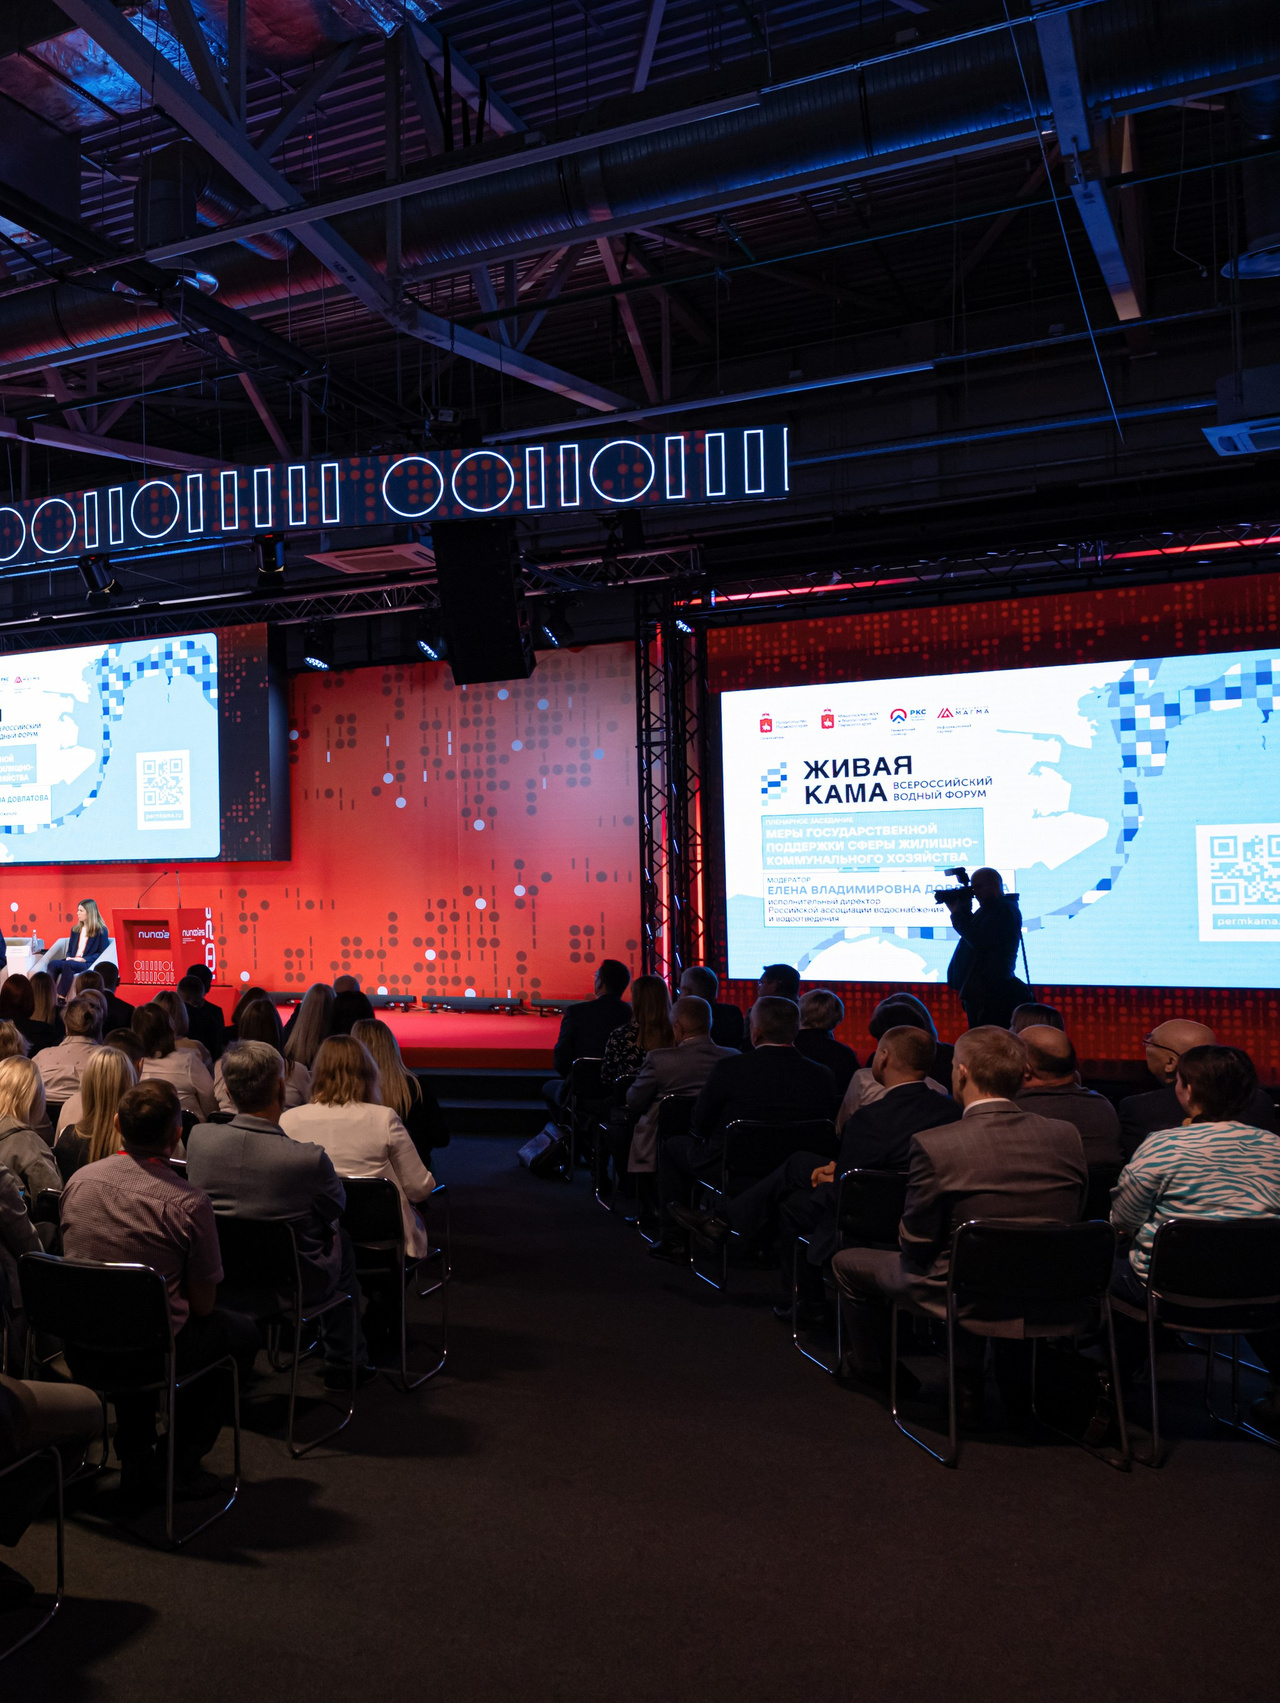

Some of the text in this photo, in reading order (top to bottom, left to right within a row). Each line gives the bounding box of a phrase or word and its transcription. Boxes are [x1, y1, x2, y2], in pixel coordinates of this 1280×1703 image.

[910, 708, 926, 716] РКС
[803, 755, 913, 780] ЖИВАЯ
[893, 776, 993, 790] ВСЕРОССИЙСКИЙ
[805, 782, 888, 805] КАМА
[893, 789, 987, 802] ВОДНЫЙ ФОРУМ
[766, 822, 938, 839] МЕРЫ ГОСУДАРСТВЕННОЙ
[766, 837, 979, 854] ПОДДЕРЖКИ СФЕРЫ ЖИЛИЩНО-
[766, 850, 969, 866] КОММУНАЛЬНОГО ХОЗЯЙСТВА
[767, 884, 808, 895] ЕЛЕНА
[811, 884, 921, 896] ВЛАДИМИРОВНА
[767, 897, 881, 906] исполнительный директор
[768, 905, 944, 915] Российской ассоциации водоснабжения
